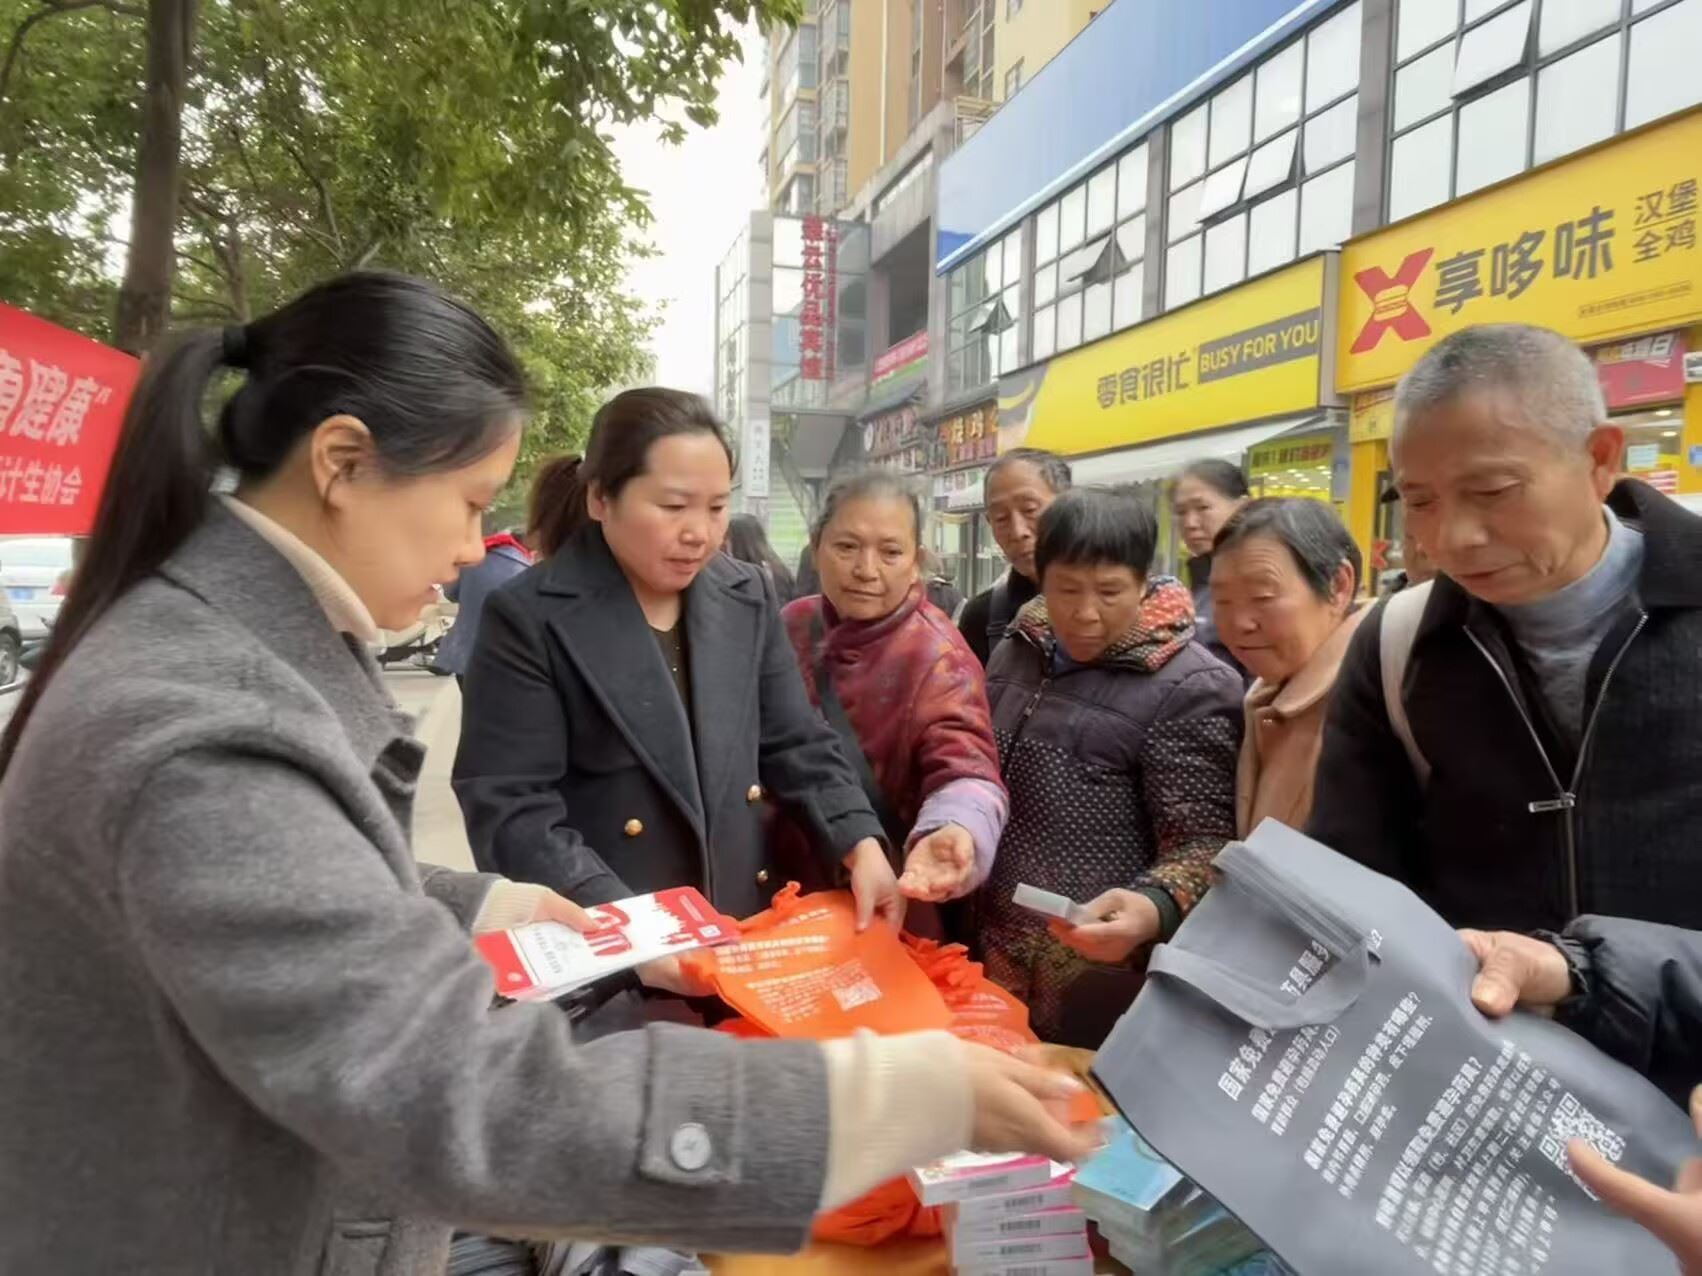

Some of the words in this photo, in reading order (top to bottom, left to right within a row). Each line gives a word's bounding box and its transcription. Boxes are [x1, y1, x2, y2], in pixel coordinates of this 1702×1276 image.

[1633, 178, 1698, 226] 汉堡
[1433, 205, 1617, 315] 享哆味
[1632, 219, 1697, 264] 全鸡
[1200, 342, 1242, 373] BUSY
[1242, 335, 1277, 362] FOR
[1279, 320, 1320, 349] YOU
[1097, 350, 1191, 410] 零食很忙
[0, 456, 83, 505] 计生协会
[1217, 1026, 1277, 1102] 国家免费
